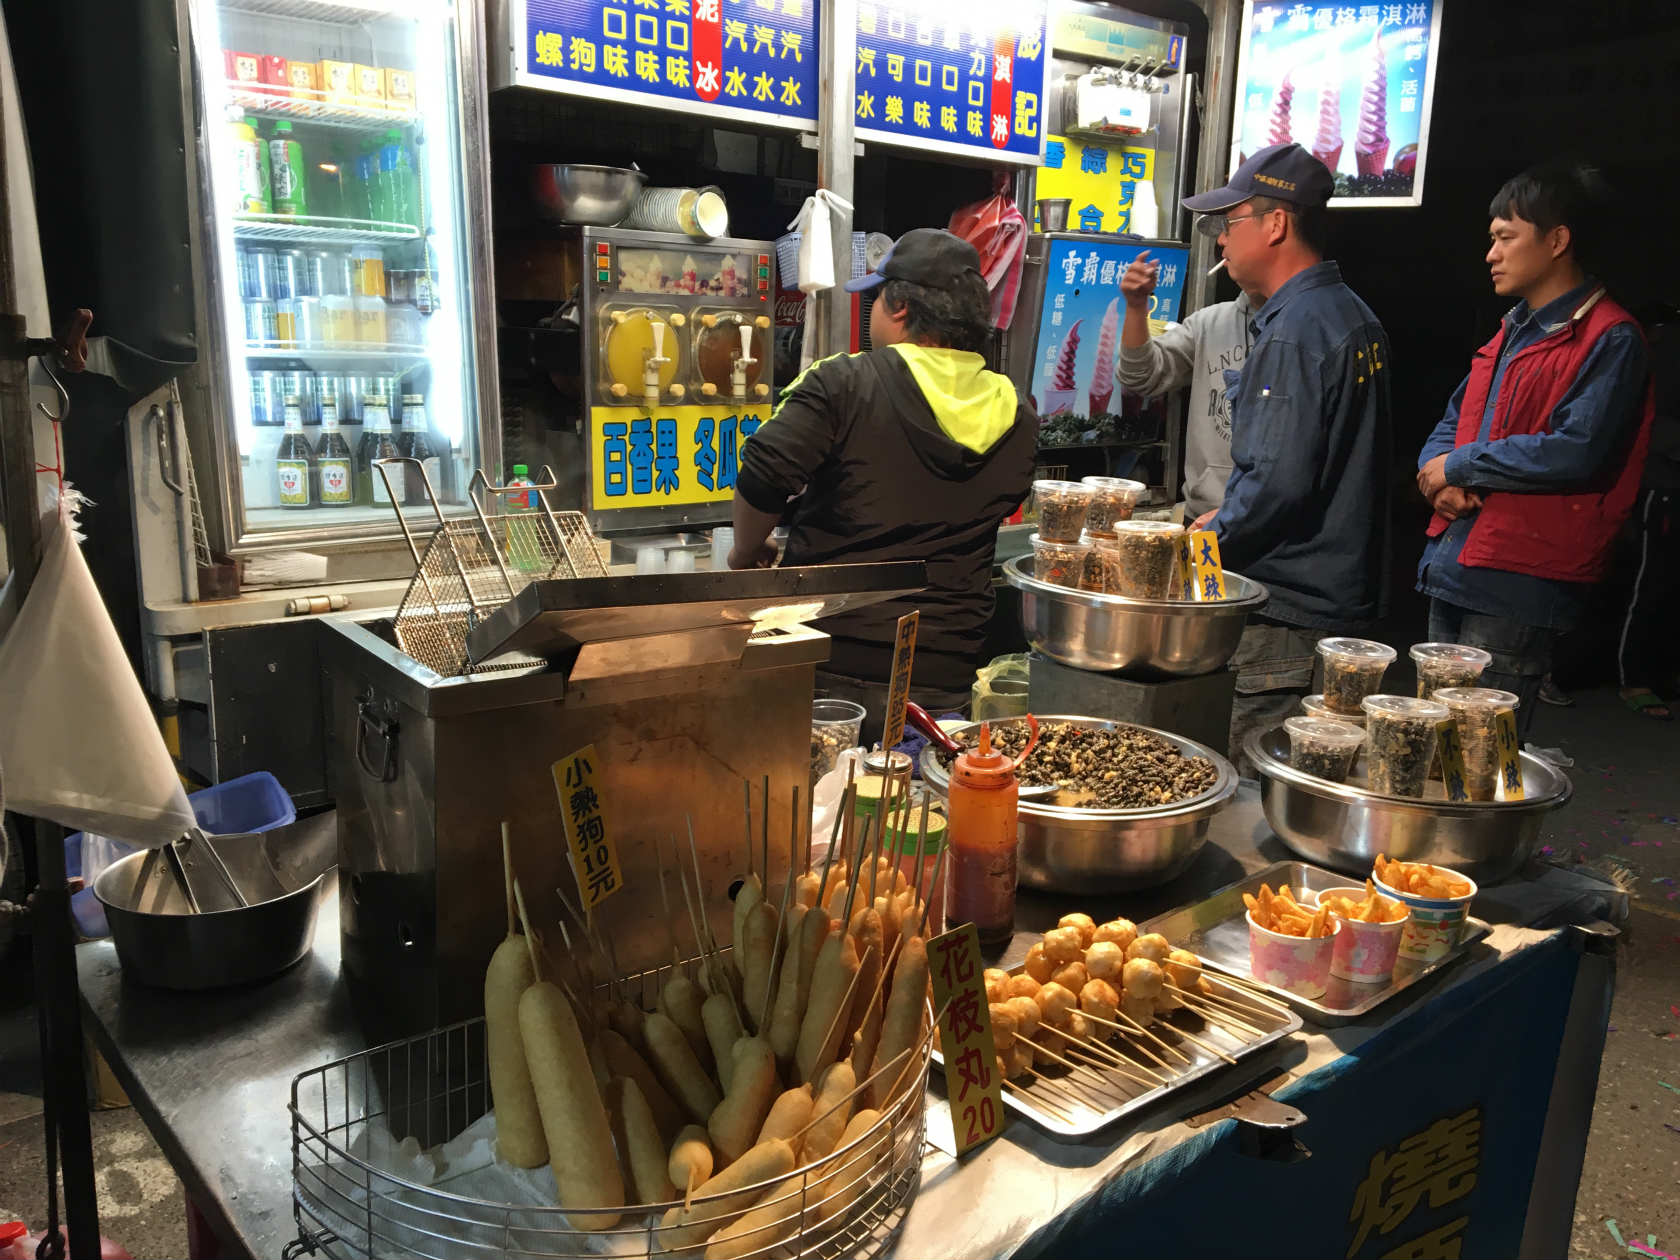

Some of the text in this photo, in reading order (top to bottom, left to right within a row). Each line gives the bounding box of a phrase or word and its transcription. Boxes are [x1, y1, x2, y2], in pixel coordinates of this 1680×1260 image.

[569, 36, 596, 73] 狗
[1062, 250, 1177, 287] 雪霸優淋
[603, 417, 679, 496] 百香果
[936, 933, 996, 1147] 花枝丸20
